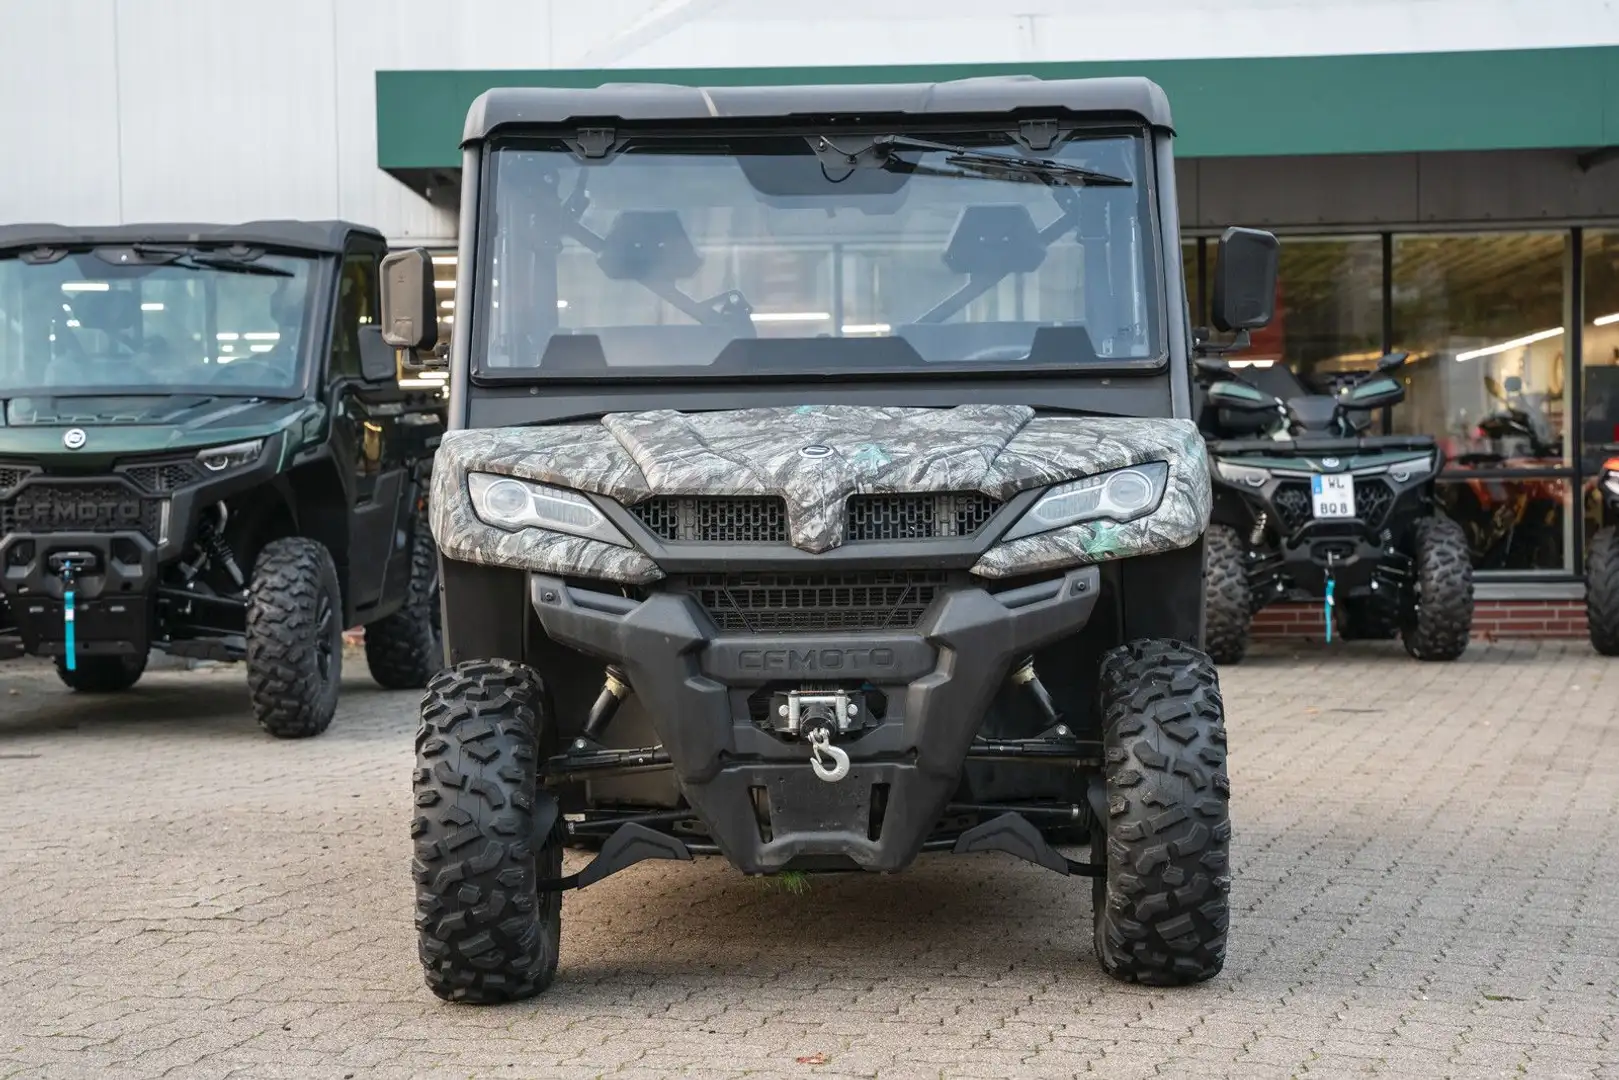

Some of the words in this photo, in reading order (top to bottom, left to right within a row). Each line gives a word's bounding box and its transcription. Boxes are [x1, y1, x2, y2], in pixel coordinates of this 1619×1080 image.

[1327, 475, 1345, 488] WL
[14, 502, 140, 520] CFMOTO
[738, 648, 895, 670] CFMOTO
